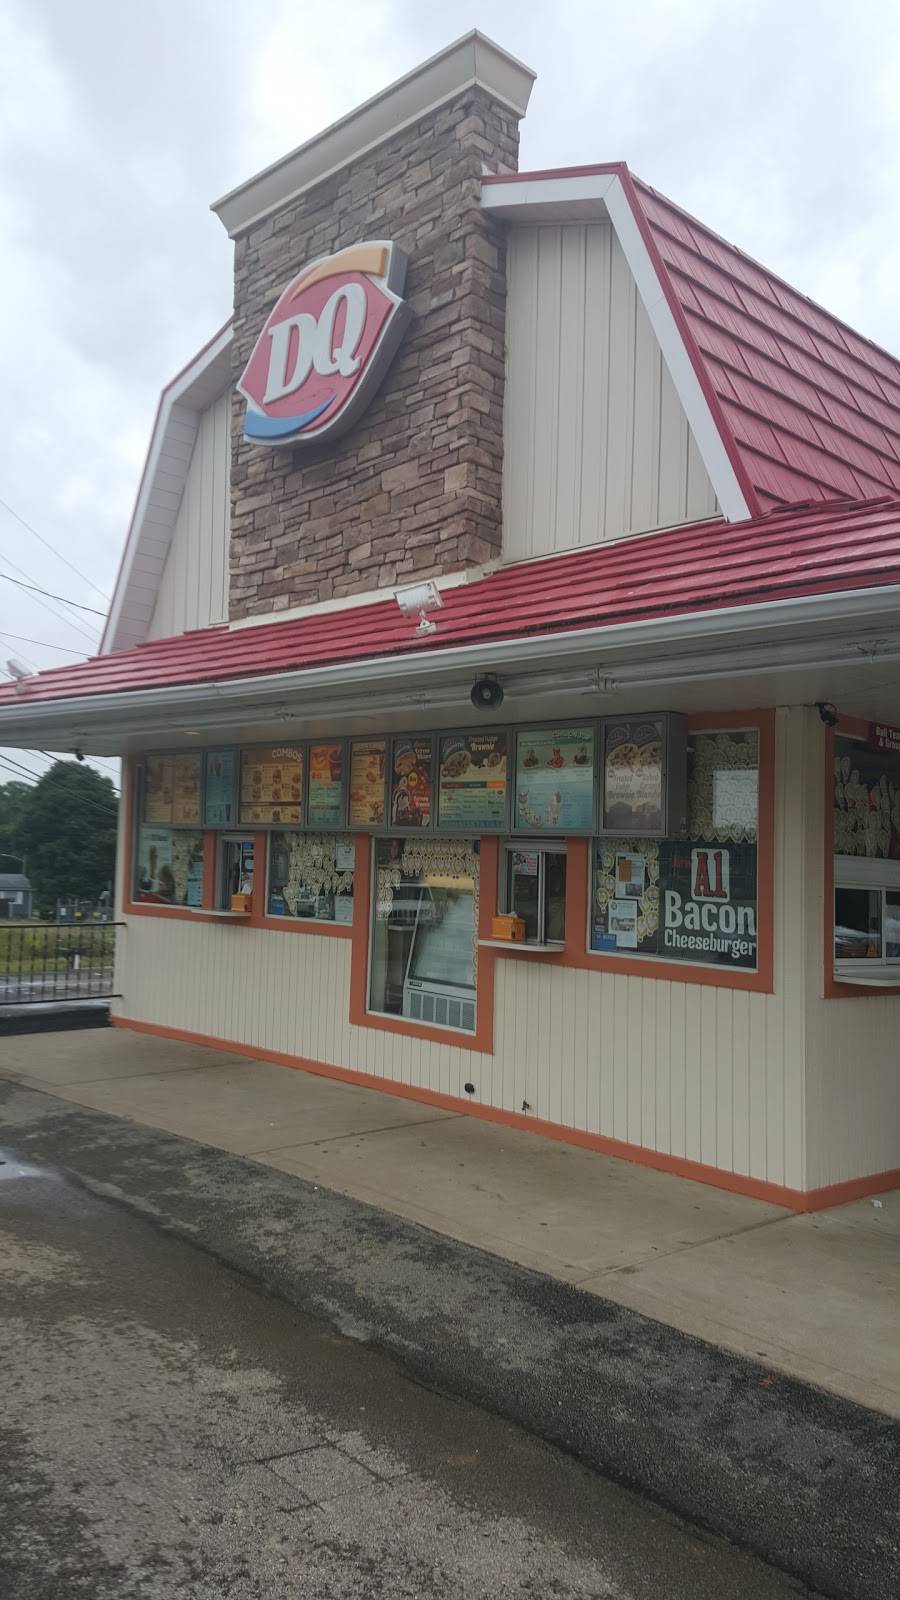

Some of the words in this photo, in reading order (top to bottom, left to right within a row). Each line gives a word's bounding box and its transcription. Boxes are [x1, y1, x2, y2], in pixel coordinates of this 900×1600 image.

[263, 282, 367, 405] DQ
[271, 747, 303, 762] COMBOS
[664, 890, 758, 936] Bacon
[664, 929, 757, 959] Cheeseburger
